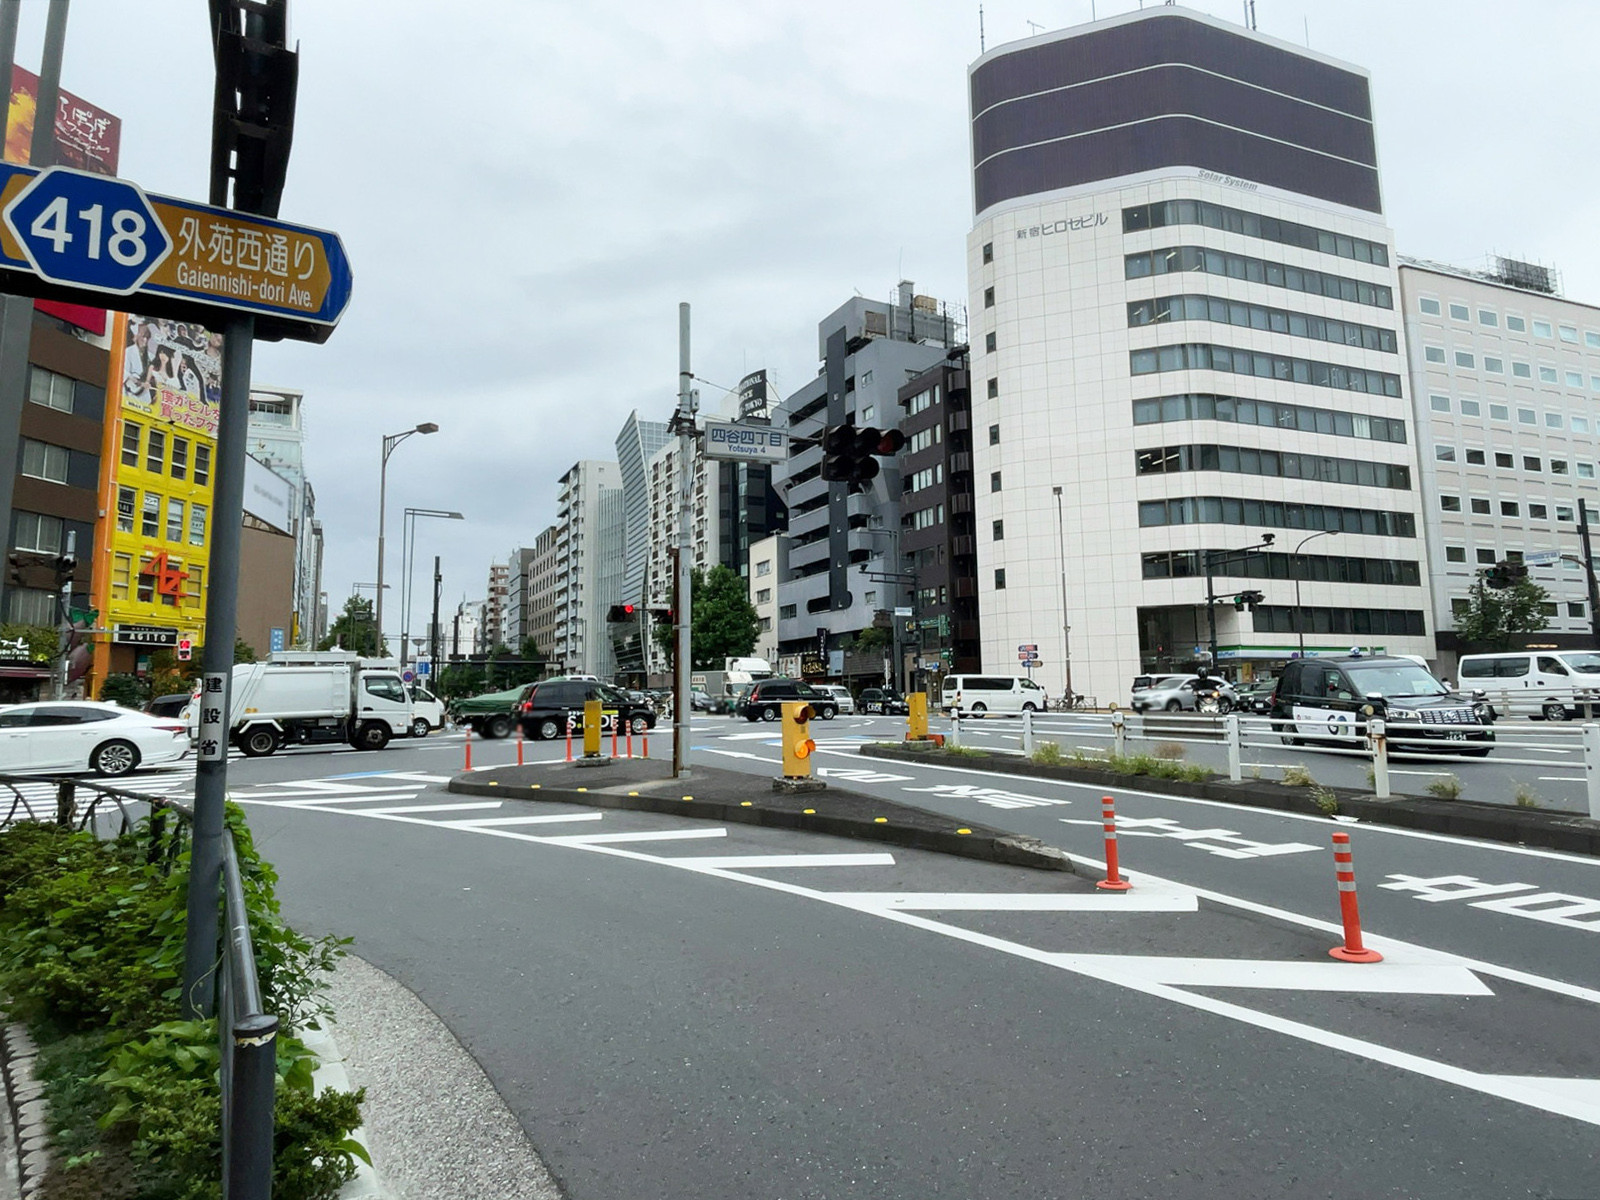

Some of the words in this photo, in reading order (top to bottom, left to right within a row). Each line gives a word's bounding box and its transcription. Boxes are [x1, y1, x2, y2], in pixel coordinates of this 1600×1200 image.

[1198, 169, 1223, 182] Solar
[1224, 176, 1258, 191] System
[31, 197, 147, 267] 418
[1017, 212, 1108, 239] 新宿ヒロセビル
[178, 216, 315, 280] 外苑西通り
[177, 261, 285, 302] Gaiennishi-dori
[288, 283, 313, 308] Ave.
[712, 428, 781, 446] 四谷四丁目
[728, 444, 757, 454] Yotsuya
[129, 632, 167, 642] AGITO
[201, 677, 223, 755] 建設省
